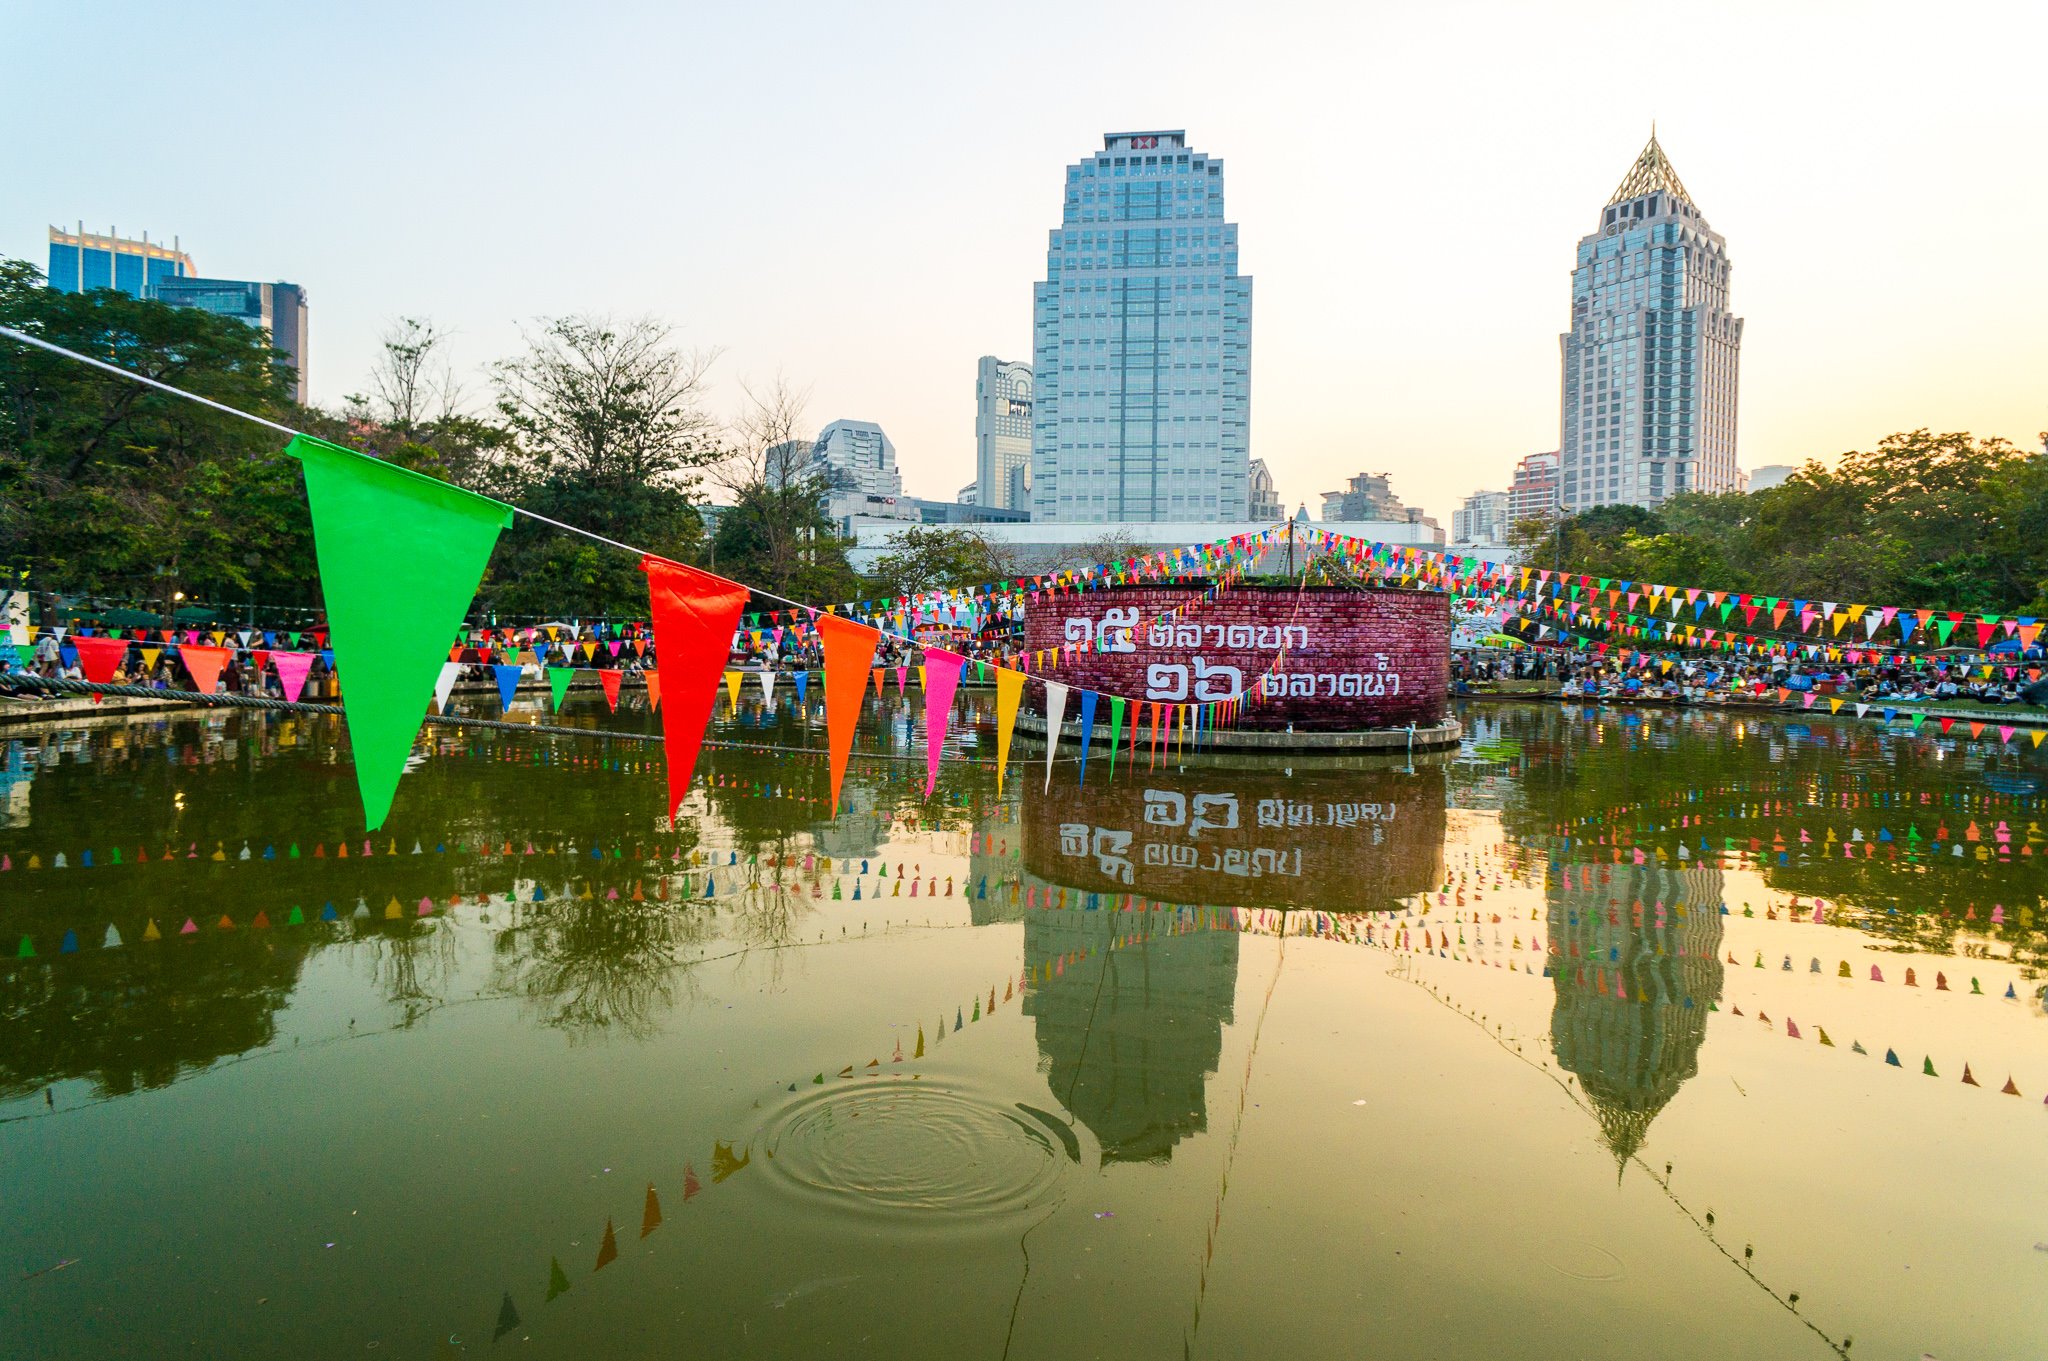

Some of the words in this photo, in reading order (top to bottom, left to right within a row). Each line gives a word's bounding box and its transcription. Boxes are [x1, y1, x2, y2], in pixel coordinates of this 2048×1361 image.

[1064, 606, 1140, 653] ๑๕
[1149, 624, 1308, 649] ตลาดบก
[1146, 655, 1243, 701] ๑๖
[1261, 652, 1400, 697] ตลาดน้ำ
